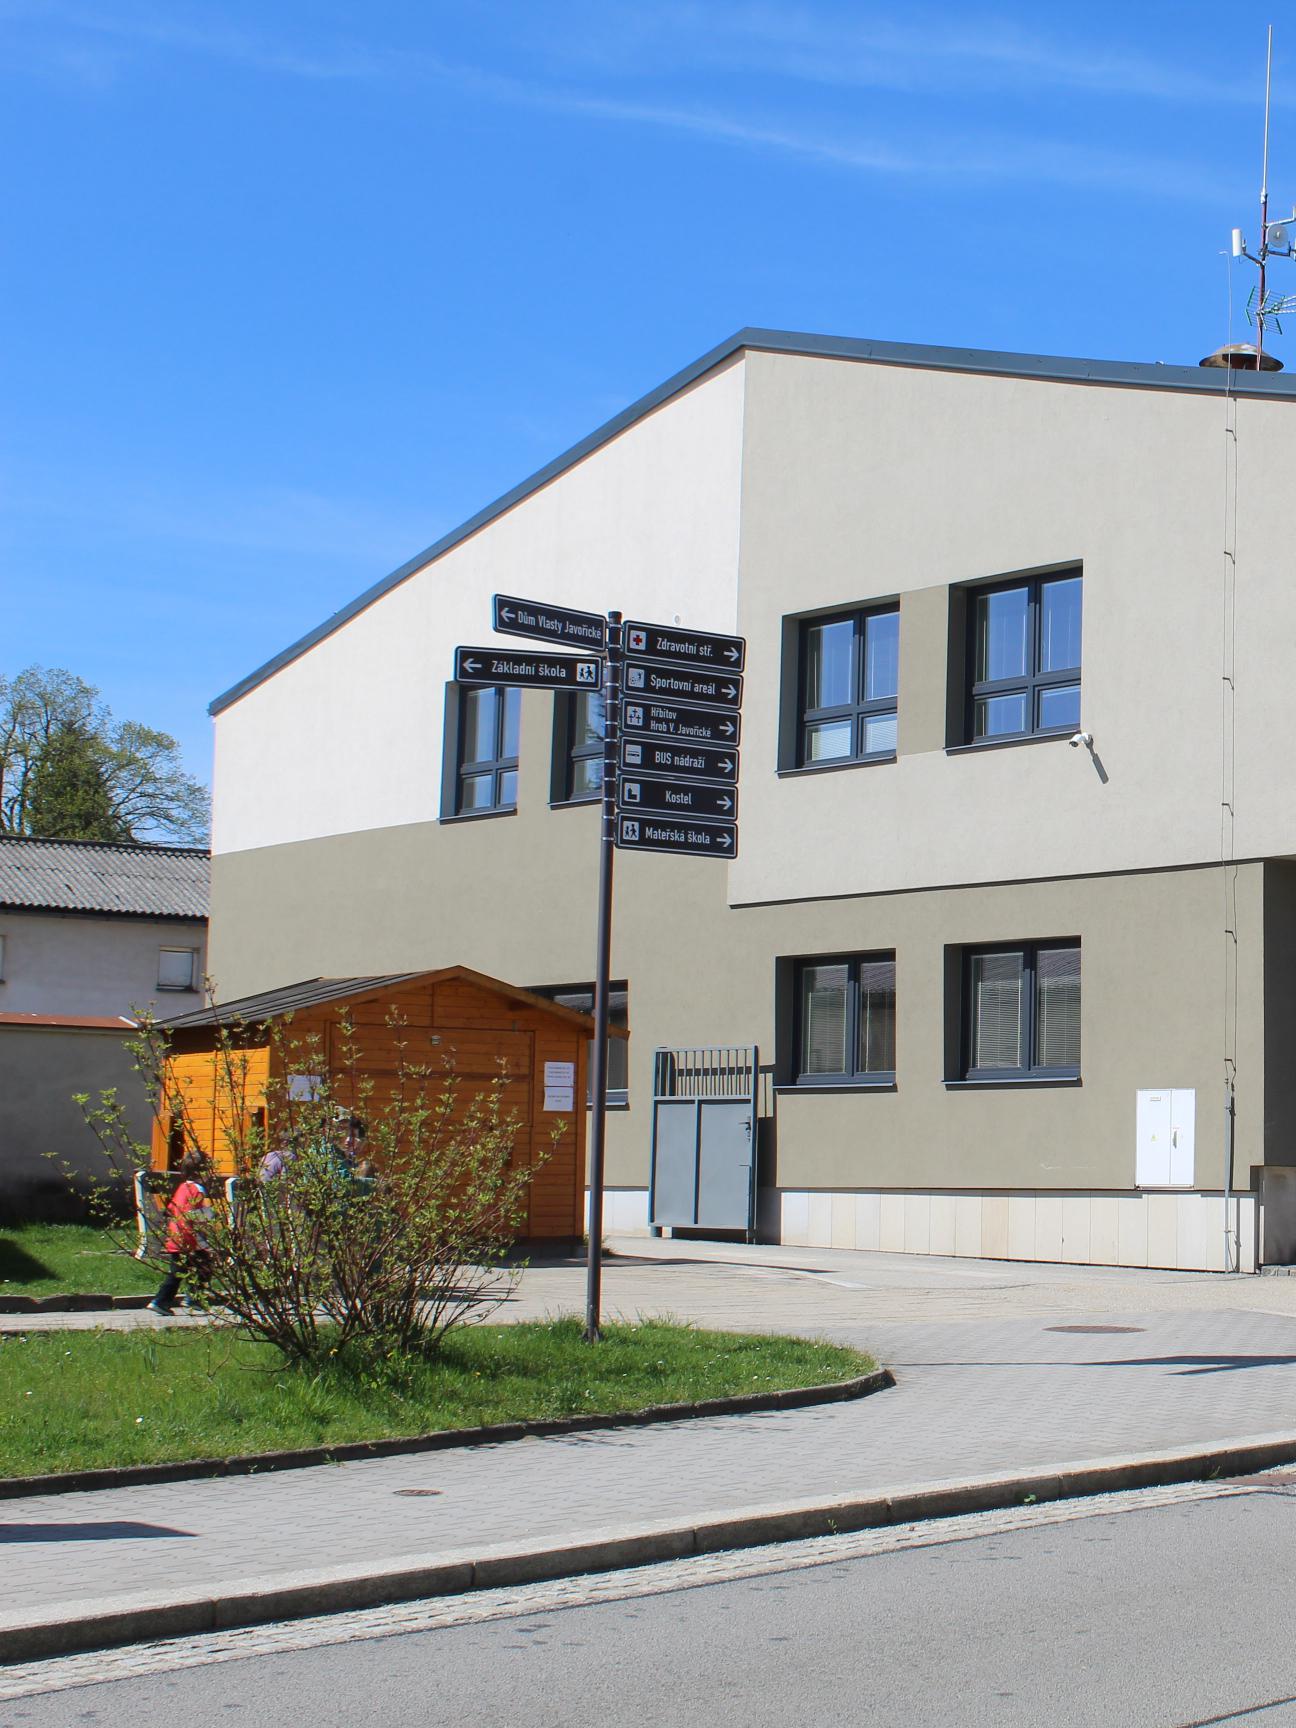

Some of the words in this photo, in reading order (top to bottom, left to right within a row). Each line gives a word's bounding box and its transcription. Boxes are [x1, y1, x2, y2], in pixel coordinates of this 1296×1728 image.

[517, 610, 536, 626] Dům
[538, 615, 562, 633] Vlasty
[564, 621, 602, 640] Javořické
[656, 637, 698, 655] Zdravotní
[699, 645, 713, 657] stř.
[491, 660, 536, 676] Základní
[538, 663, 566, 678] škola
[650, 674, 692, 692] Sportovní
[693, 682, 716, 695] areál
[650, 706, 677, 720] Hřbitov
[650, 720, 667, 732] Hrob
[669, 722, 676, 733] V.
[677, 724, 712, 738] Javořické
[655, 751, 672, 764] BUS
[674, 754, 706, 769] nádraží
[665, 790, 692, 805] Kostel
[645, 827, 685, 842] Mateřská
[687, 831, 710, 844] škola
